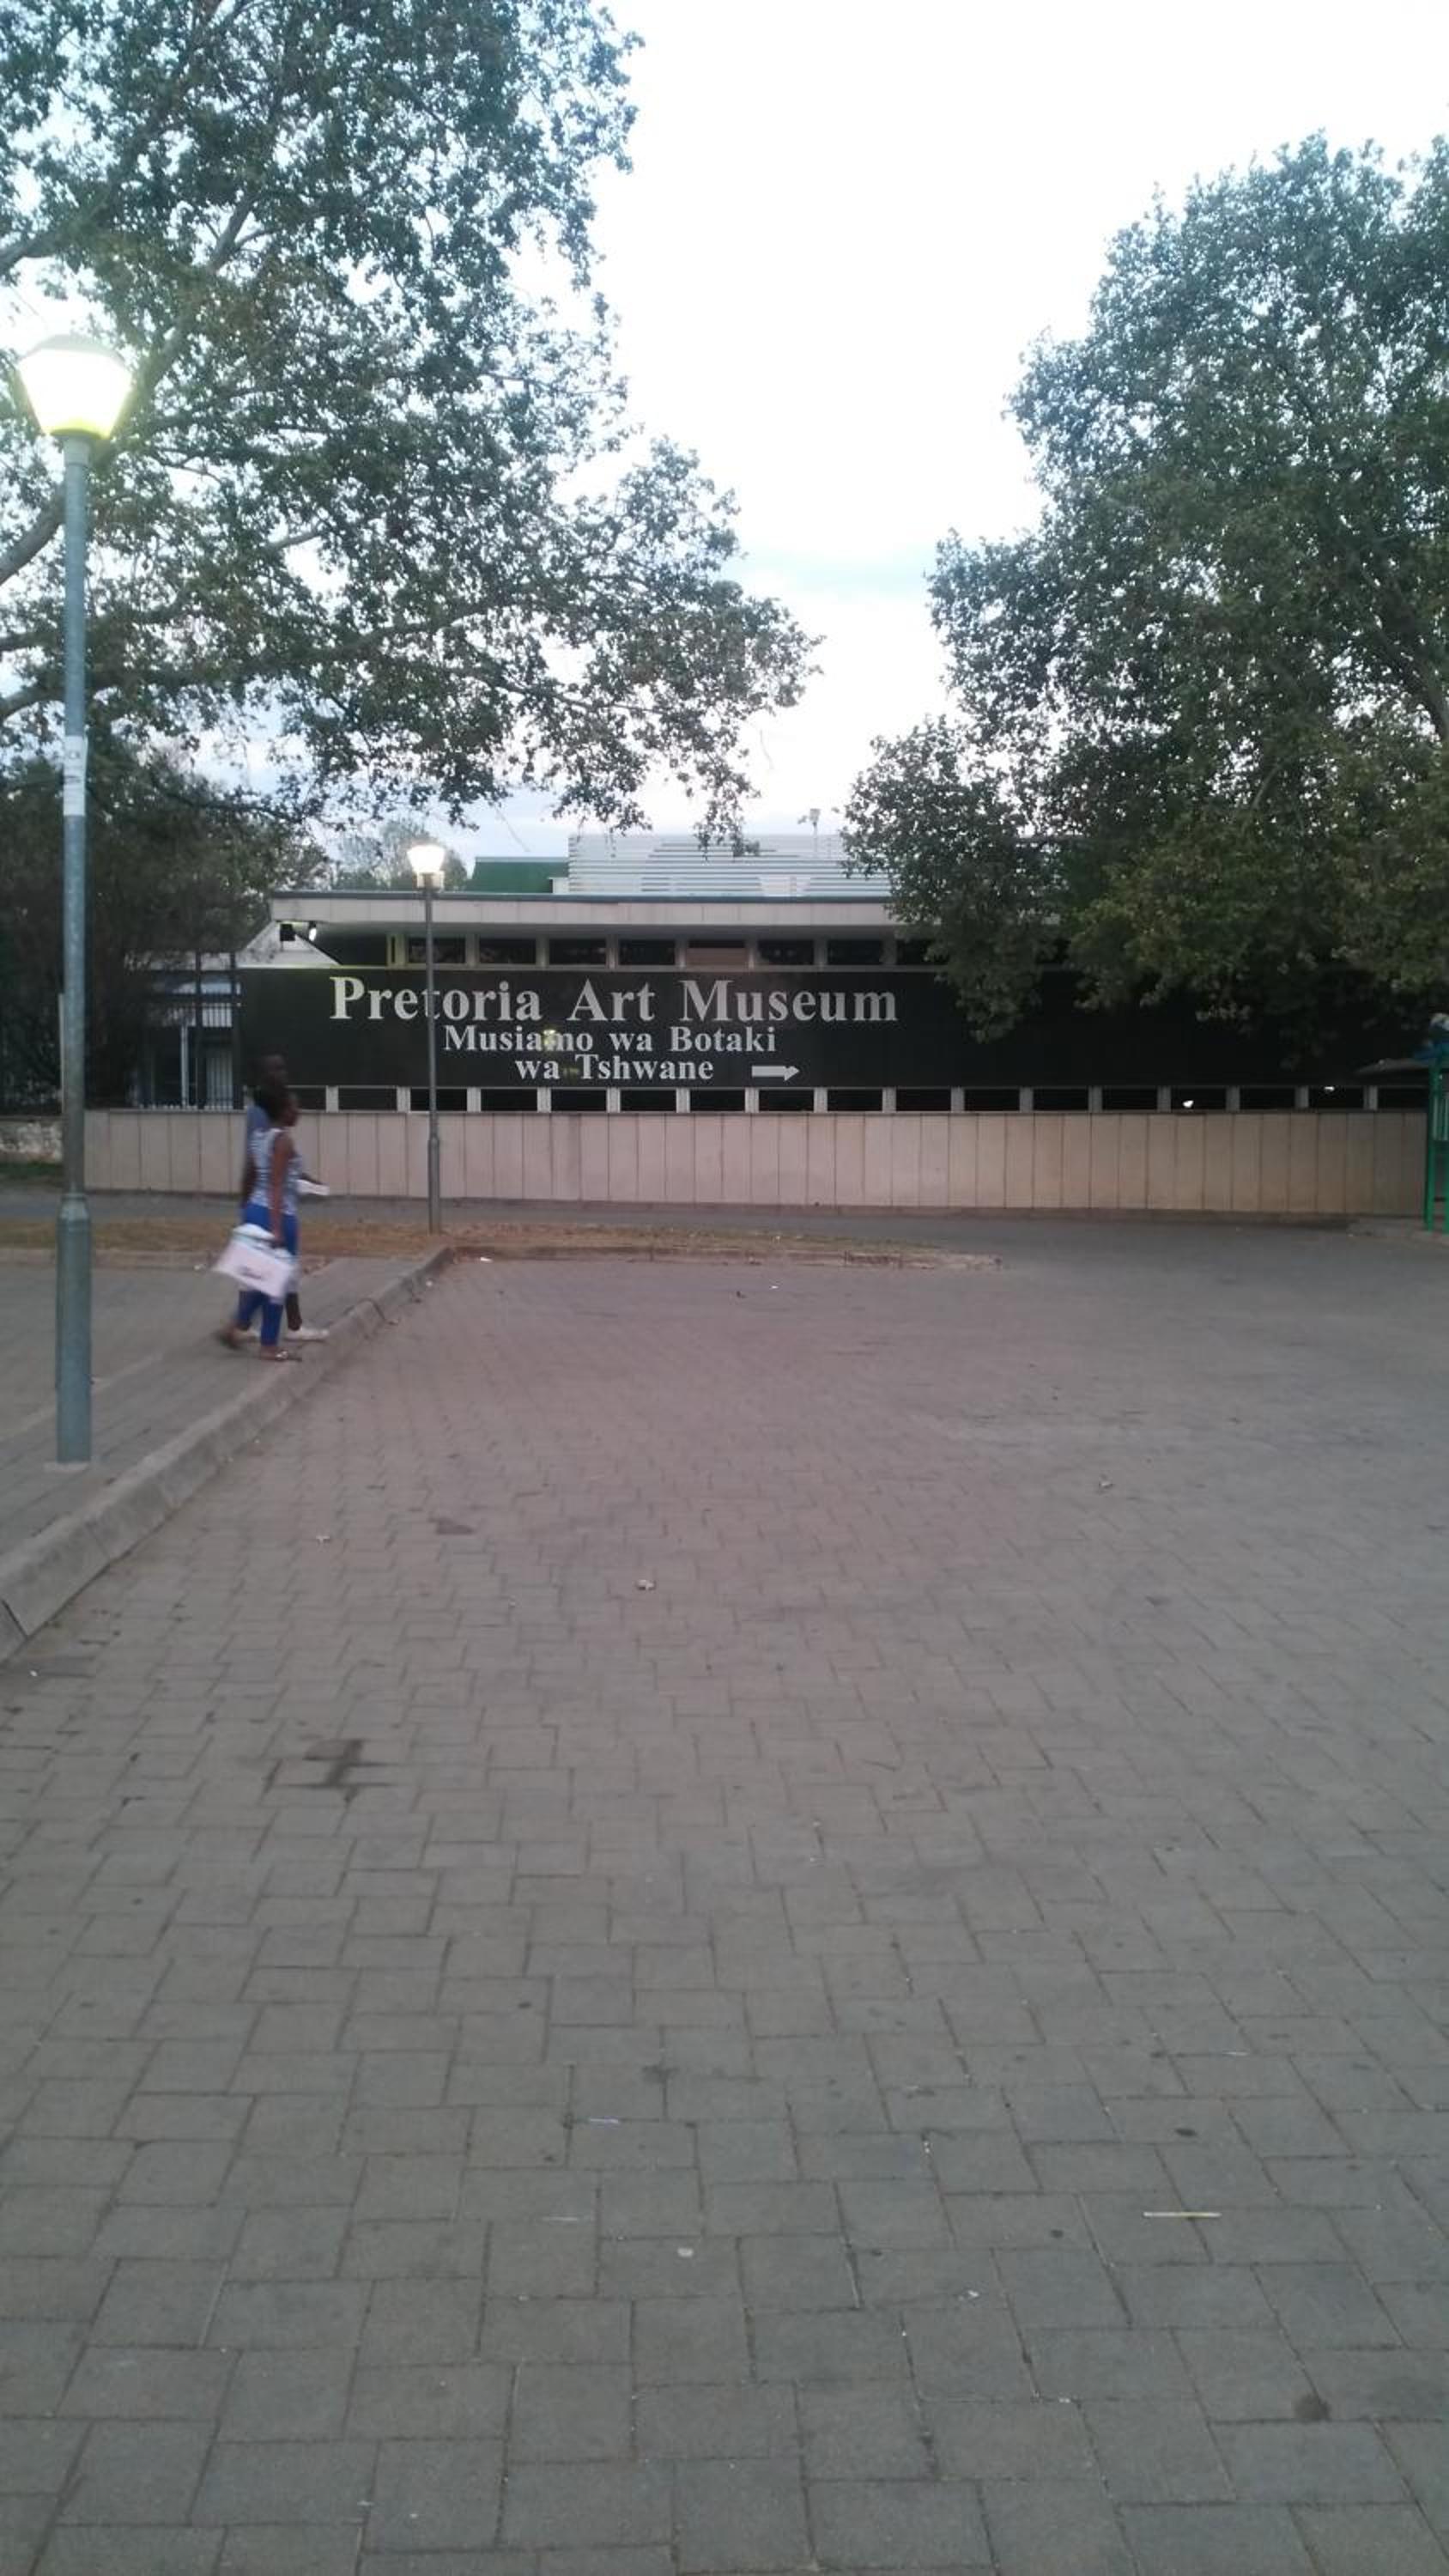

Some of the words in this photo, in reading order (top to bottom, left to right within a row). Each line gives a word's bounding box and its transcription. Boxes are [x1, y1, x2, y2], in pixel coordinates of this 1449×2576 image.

[330, 976, 541, 1021] Pretoria
[567, 978, 655, 1021] Art
[680, 979, 898, 1021] Museum
[444, 1024, 593, 1051] Musiamo
[609, 1031, 653, 1051] wa
[670, 1026, 777, 1052] Botaki
[515, 1060, 560, 1079] wa
[575, 1054, 714, 1080] Tshwane
